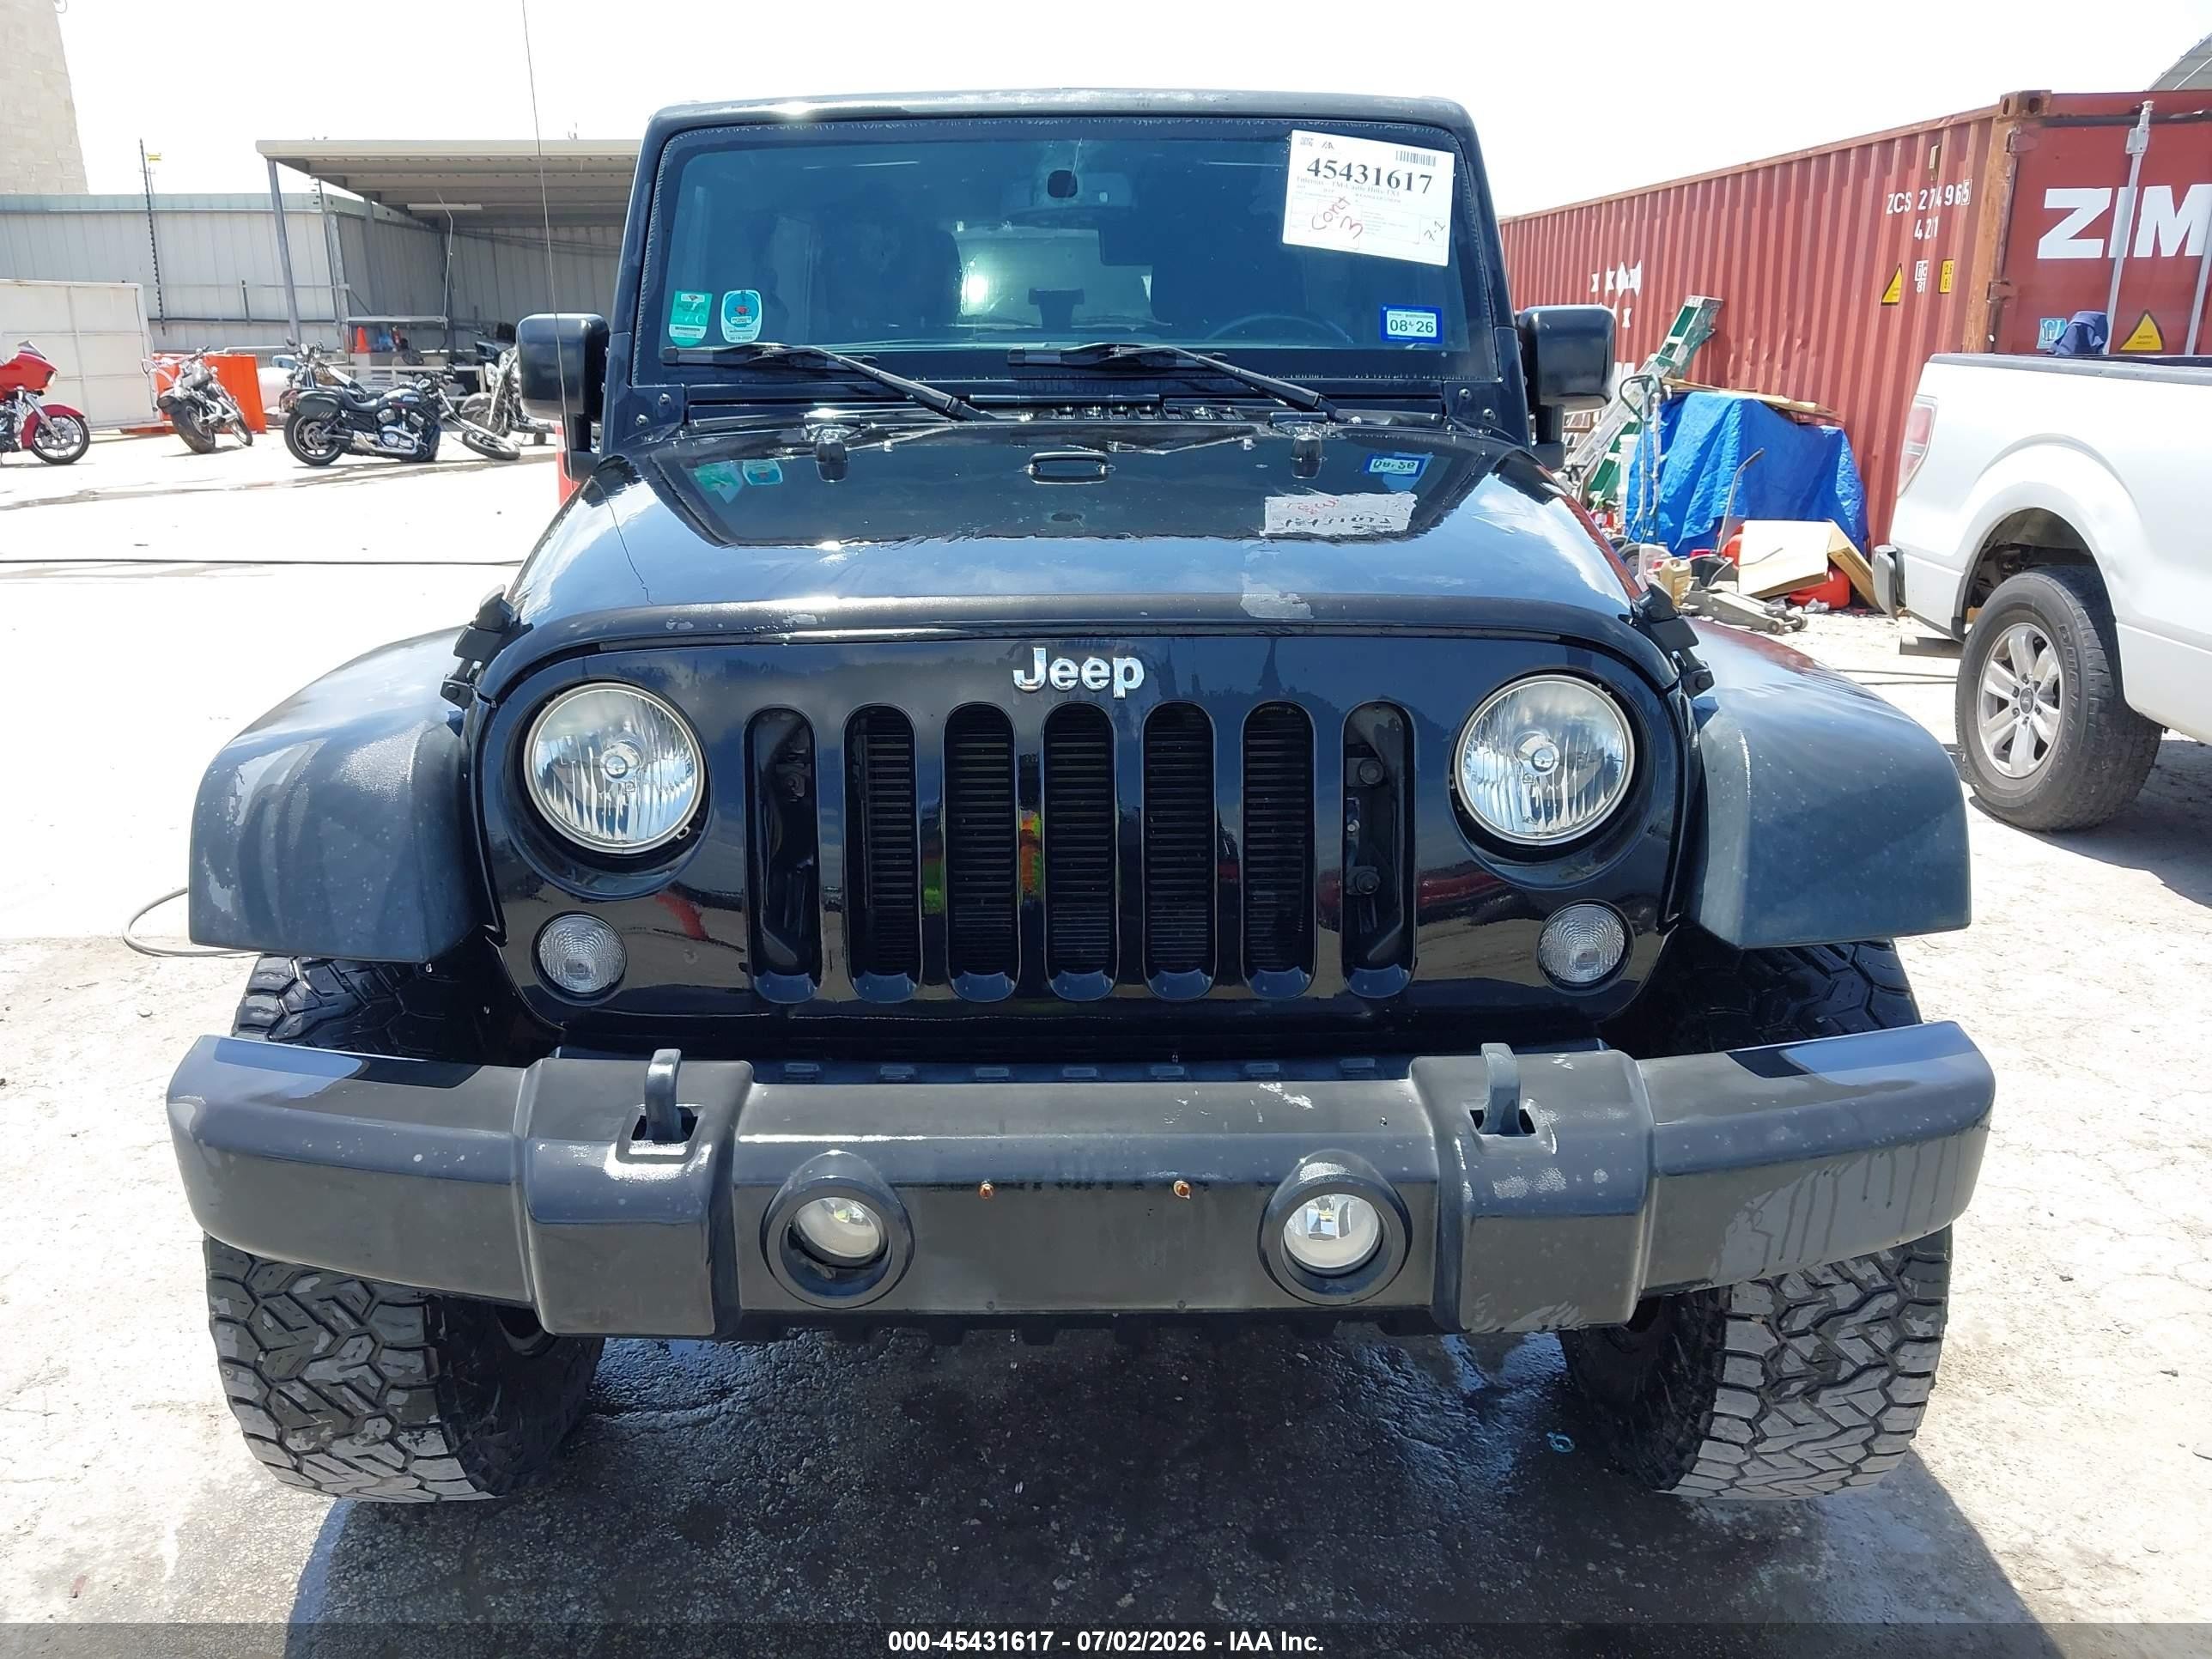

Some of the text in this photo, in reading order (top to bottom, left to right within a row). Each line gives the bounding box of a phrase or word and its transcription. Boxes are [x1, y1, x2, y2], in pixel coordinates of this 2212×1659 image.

[1307, 158, 1432, 194] 45431617
[1886, 191, 1912, 215] ZCS
[2037, 184, 2212, 258] ZIM
[1390, 319, 1434, 333] 08 26
[1013, 647, 1145, 698] Jeep
